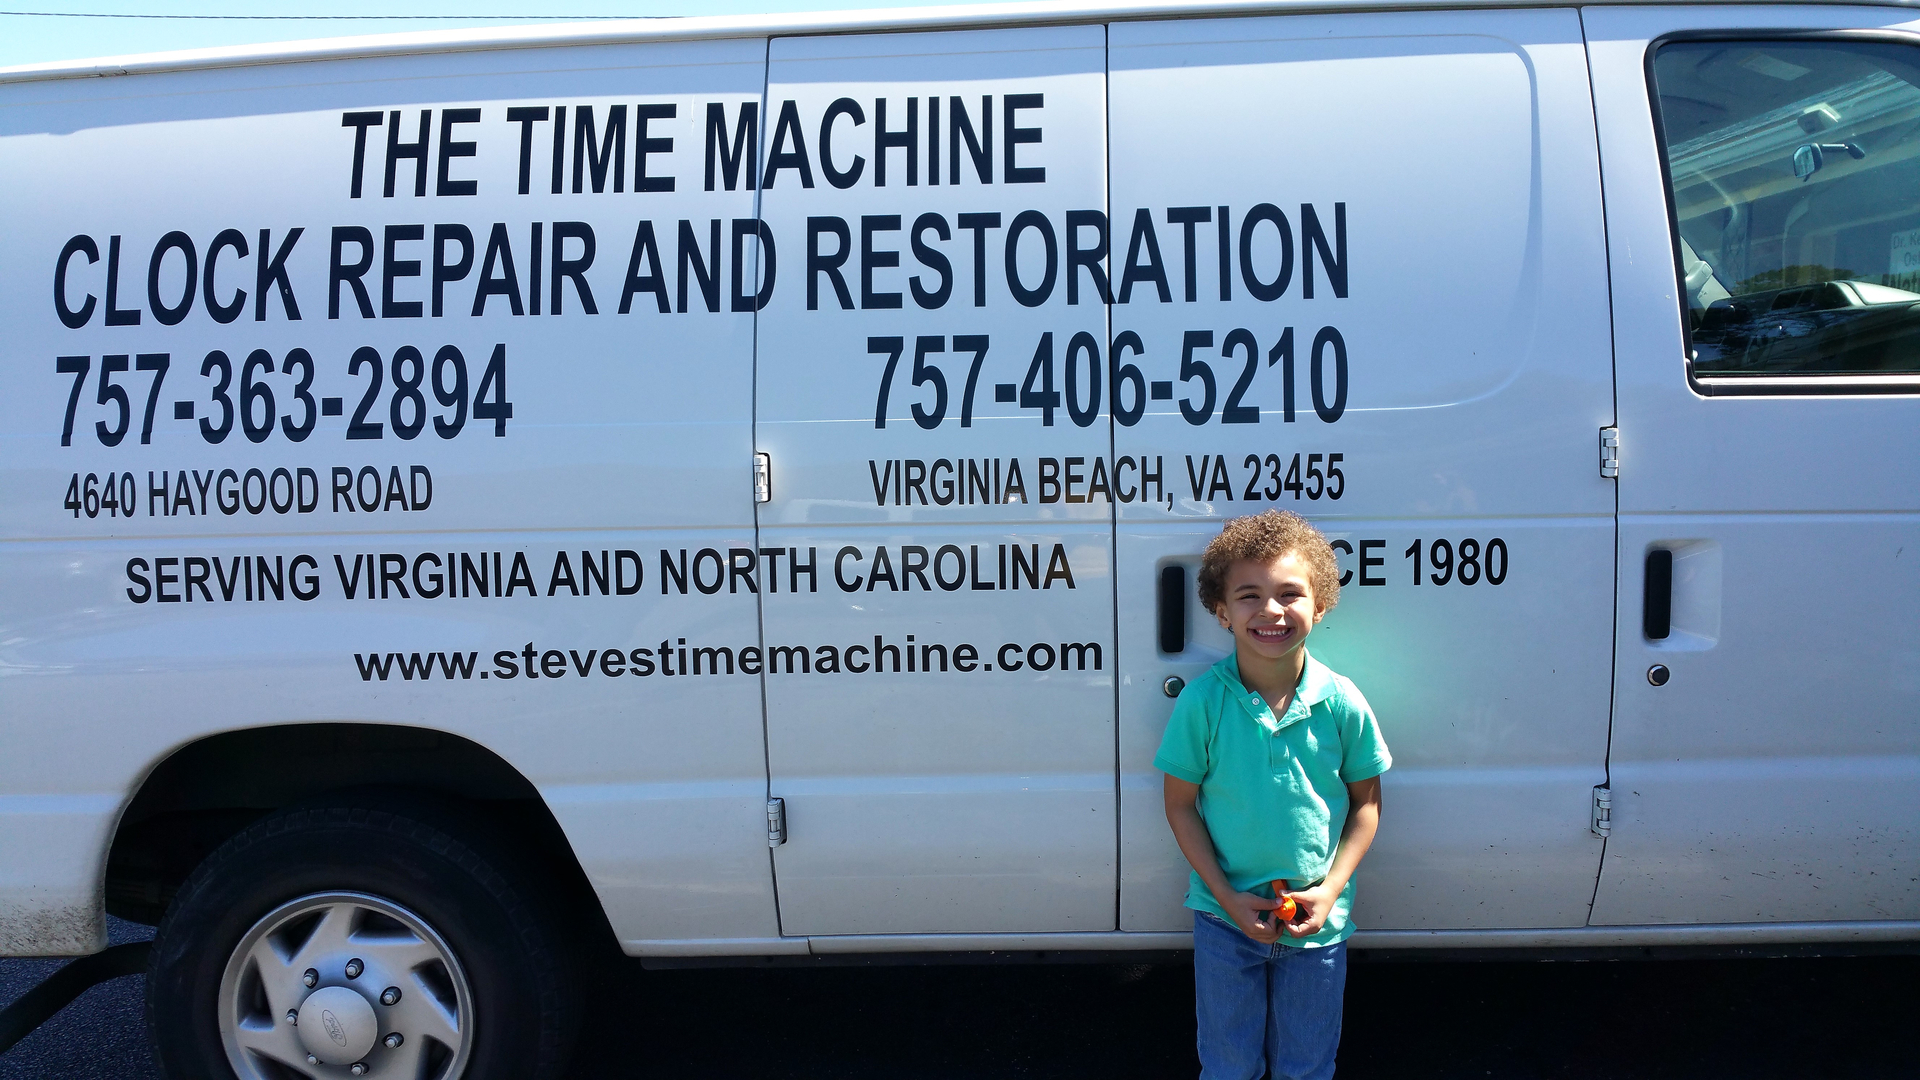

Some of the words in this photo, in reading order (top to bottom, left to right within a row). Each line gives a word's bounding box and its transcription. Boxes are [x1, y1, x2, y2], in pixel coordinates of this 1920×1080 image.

[342, 108, 482, 198] THE
[507, 104, 677, 194] TIME
[704, 94, 1046, 191] MACHINE
[54, 228, 305, 329] CLOCK
[328, 222, 599, 319] REPAIR
[618, 218, 777, 314] AND
[806, 202, 1349, 311] RESTORATION
[56, 343, 513, 447] 757-363-2894
[867, 325, 1349, 429] 757-406-5210
[64, 471, 137, 518] 4640
[148, 467, 319, 517] HAYGOOD
[331, 465, 433, 512] ROAD
[868, 458, 1029, 506] VIRGINIA
[1038, 455, 1174, 511] BEACH,
[1185, 454, 1234, 501] VA
[1243, 453, 1345, 501] 23455
[126, 555, 320, 604] SERVING
[333, 551, 538, 600] VIRGINIA
[546, 549, 644, 597] AND
[660, 546, 818, 595] NORTH
[834, 543, 1077, 593] CAROLINA
[1405, 537, 1509, 586] 1980
[353, 635, 1103, 682] www.stevestimemachine.com
